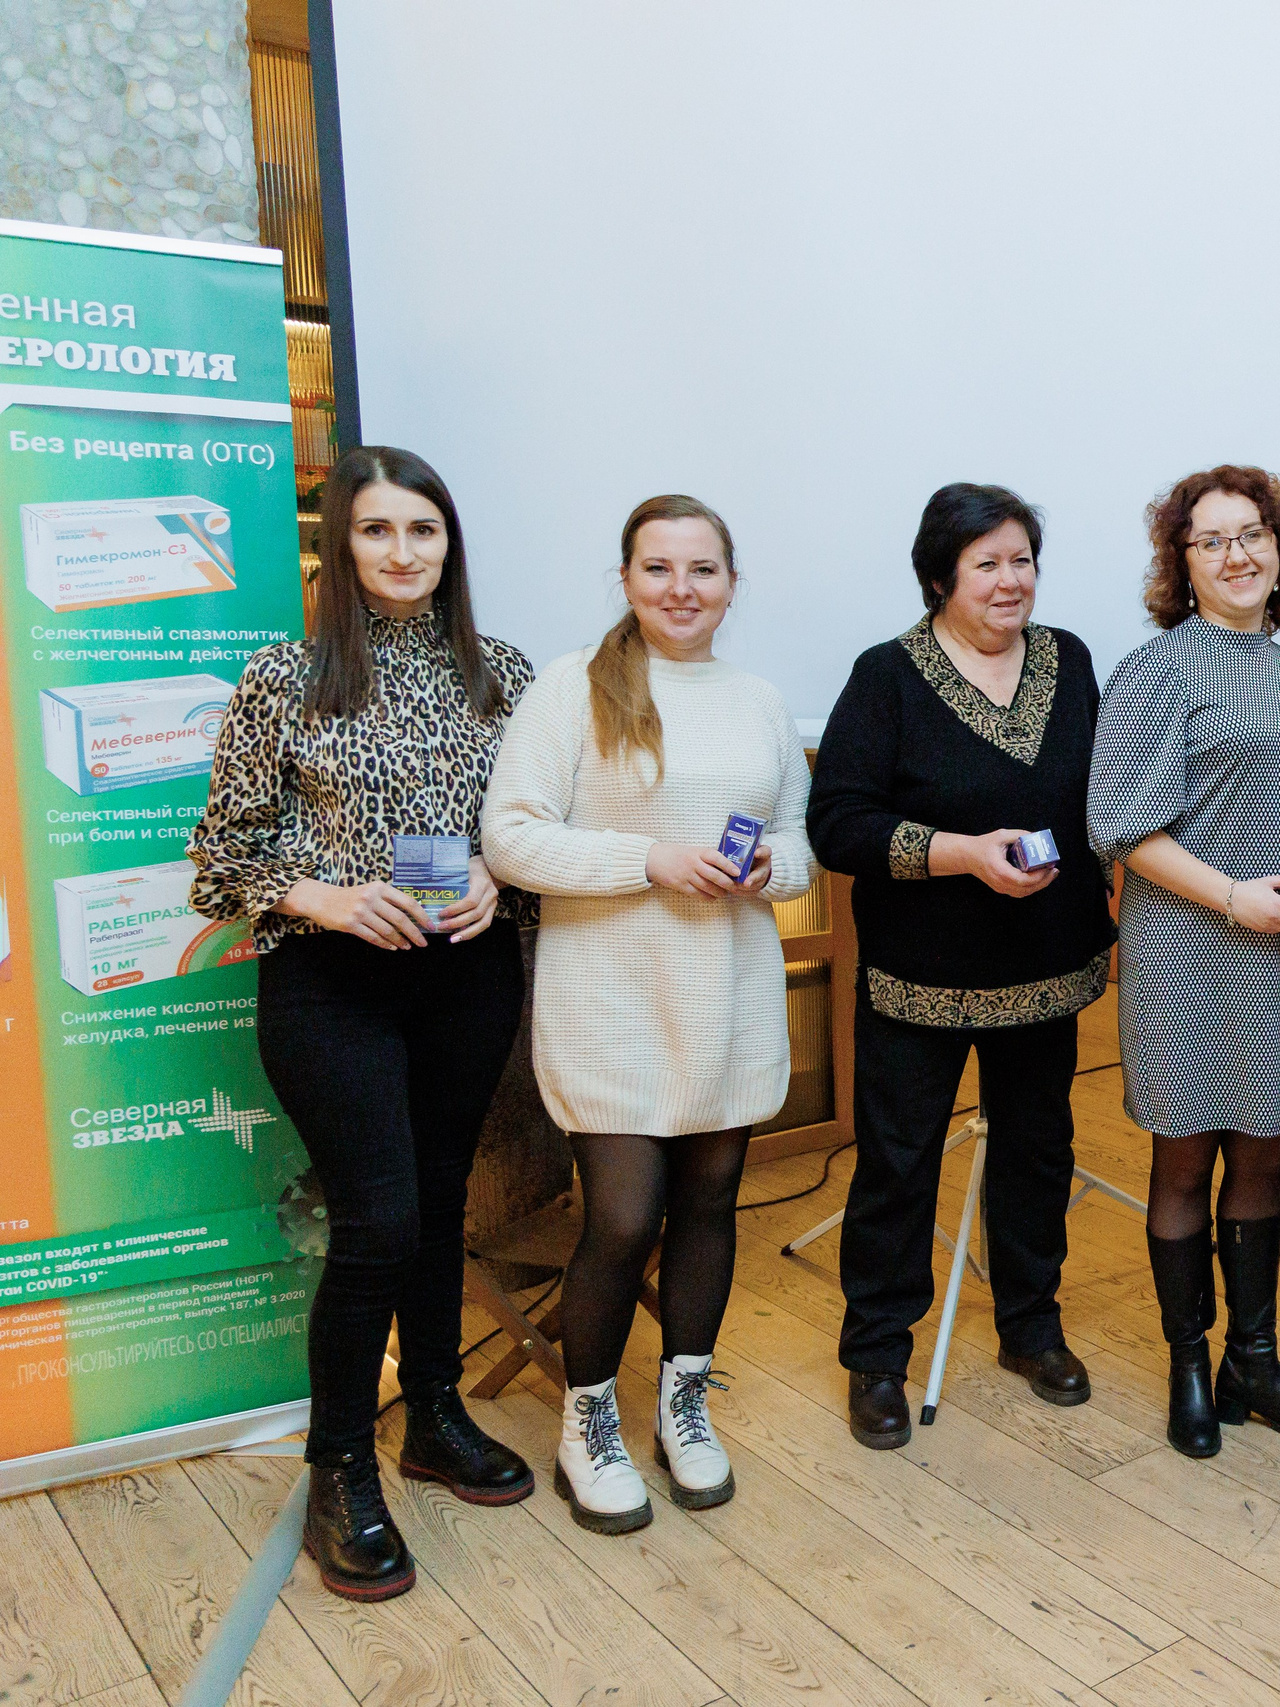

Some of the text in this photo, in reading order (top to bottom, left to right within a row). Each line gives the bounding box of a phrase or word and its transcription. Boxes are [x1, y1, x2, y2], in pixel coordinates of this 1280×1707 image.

[0, 293, 136, 329] енная
[0, 336, 237, 382] ЕРОЛОГИЯ
[10, 431, 65, 453] Без
[75, 436, 194, 461] рецепта
[58, 583, 72, 592] 50
[115, 578, 125, 586] по
[127, 575, 146, 584] 200
[31, 625, 289, 642] Селективный спазмолитик
[33, 646, 256, 663] с желчегонным действ
[93, 766, 107, 775] 50
[156, 756, 173, 764] 135
[46, 805, 172, 823] Селективный
[48, 832, 84, 846] при
[89, 828, 135, 842] боли
[141, 829, 152, 839] и
[89, 929, 144, 944] Рабепразол
[91, 957, 139, 976] 10 мг
[227, 948, 242, 959] 10
[97, 980, 109, 989] 28
[61, 997, 257, 1026] Снижение кислотнос
[62, 1016, 257, 1046] желудка, лечение из
[70, 1099, 207, 1128] Северная
[72, 1121, 185, 1149] ЗВЕЗДА
[42, 1266, 51, 1275] с
[55, 1246, 169, 1273] заболеваниями
[173, 1238, 229, 1255] органов
[45, 1244, 99, 1258] входят
[103, 1242, 112, 1250] в
[115, 1226, 208, 1248] клинические
[13, 1307, 72, 1325] общества
[76, 1288, 189, 1313] гастроэнтерологов
[192, 1280, 233, 1293] России
[235, 1271, 274, 1287] (НОГР)
[64, 1307, 145, 1329] пищеварения
[148, 1304, 156, 1313] в
[158, 1298, 201, 1314] период
[203, 1287, 260, 1304] пандемии
[66, 1311, 182, 1340] гастроэнтерология,
[185, 1304, 227, 1320] выпуск
[270, 1294, 277, 1304] 3
[280, 1289, 306, 1302] 2020
[18, 1314, 308, 1385] ПРОКОНСУЛЬТИРУЙТЕСЬ СО СПЕЦИАЛИСТ
